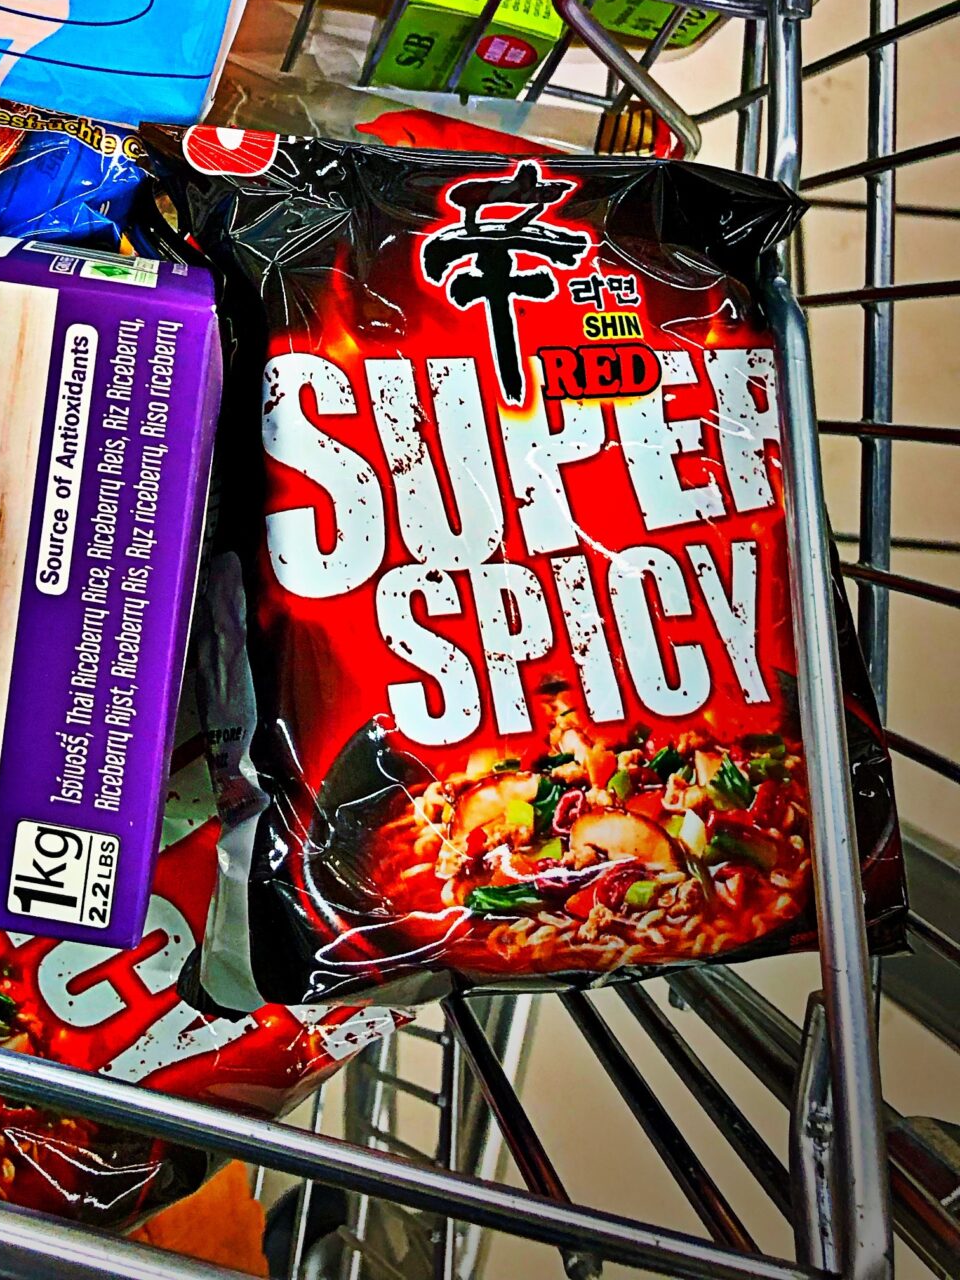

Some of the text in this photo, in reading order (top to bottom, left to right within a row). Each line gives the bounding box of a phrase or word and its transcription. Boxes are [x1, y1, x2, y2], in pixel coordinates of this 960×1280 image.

[420, 161, 595, 406] 辛
[567, 273, 640, 309] 라면
[105, 318, 145, 401] Riceberry,
[585, 314, 641, 339] SHIN
[539, 345, 661, 399] RED
[96, 436, 131, 475] Reis,
[102, 404, 130, 431] Riz
[39, 335, 89, 586] Source of Antioxidants
[262, 348, 784, 599] SUPER
[86, 478, 126, 560] Riceberry
[81, 565, 115, 604] Rice,
[94, 320, 184, 812] Riceberry Rijst, Riceberry Ris, Ryz riceberry, Riso riceberry
[70, 607, 110, 689] Riceberry
[376, 541, 773, 747] SPICY
[65, 690, 95, 725] Thai
[13, 824, 83, 914] 1kg
[88, 841, 115, 924] 2.2 LBS
